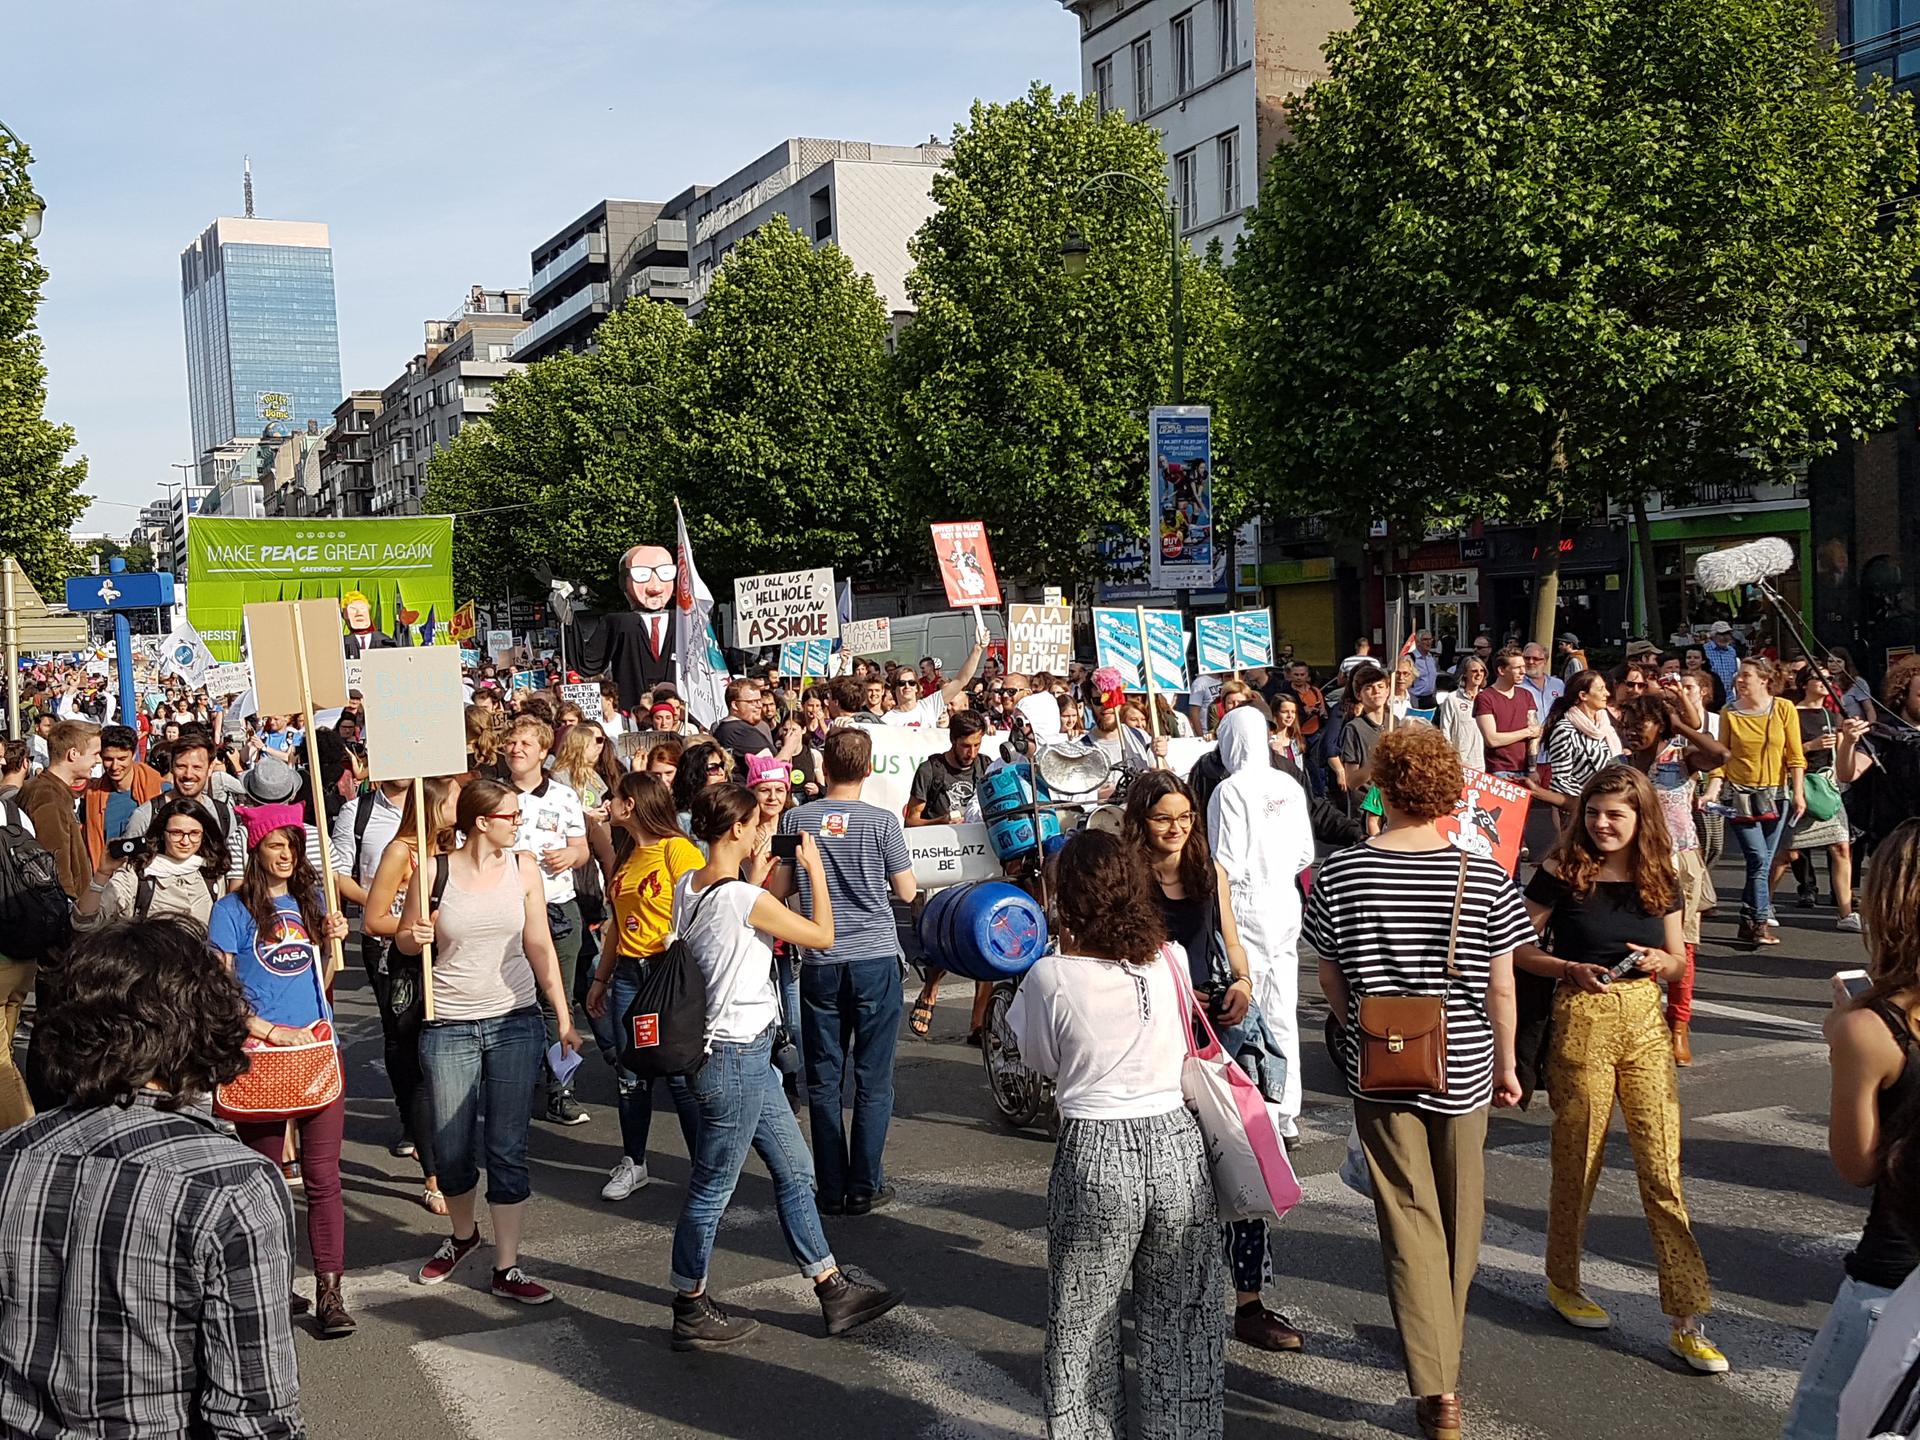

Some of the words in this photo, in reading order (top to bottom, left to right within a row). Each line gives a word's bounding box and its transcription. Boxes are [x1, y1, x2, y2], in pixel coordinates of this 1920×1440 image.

[207, 544, 255, 562] MAKE
[261, 545, 319, 562] PEACE
[324, 543, 378, 560] GREAT
[383, 543, 433, 560] AGAIN
[740, 579, 760, 594] YOU
[765, 576, 783, 587] CALL
[789, 575, 801, 583] US
[807, 573, 814, 582] A
[756, 585, 813, 606] HELLHOLE
[740, 611, 754, 620] WE
[757, 607, 780, 618] CALL
[784, 604, 805, 617] YOU
[806, 601, 824, 611] AN
[1021, 606, 1037, 623] A
[1040, 607, 1061, 624] LA
[198, 630, 238, 641] RESIST
[749, 613, 828, 645] ASSHOLE
[842, 621, 874, 633] MAKE
[1010, 620, 1071, 645] VOLONTÉ
[1028, 642, 1049, 655] DU
[1011, 653, 1067, 674] PEUPLE
[1475, 781, 1488, 791] IN
[1490, 785, 1517, 802] WAR!
[1480, 774, 1493, 784] IN
[1494, 778, 1528, 799] PEACE
[272, 950, 309, 963] NASA
